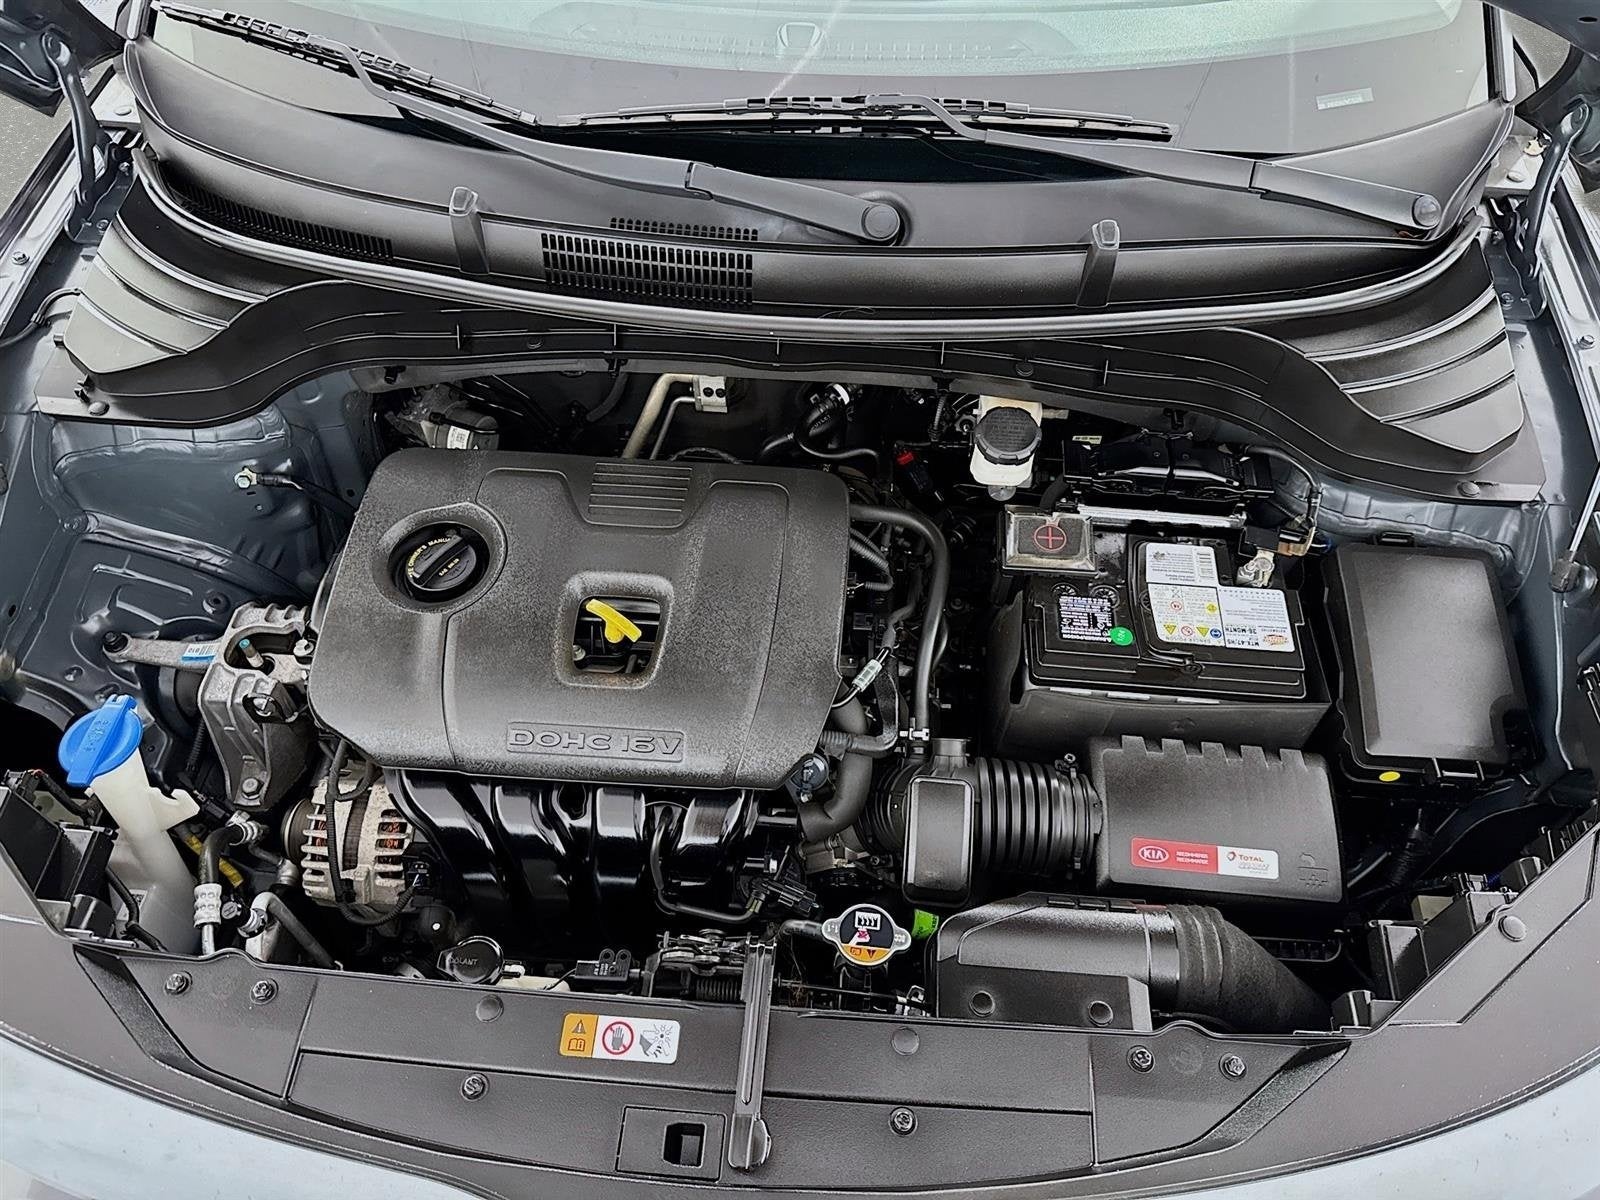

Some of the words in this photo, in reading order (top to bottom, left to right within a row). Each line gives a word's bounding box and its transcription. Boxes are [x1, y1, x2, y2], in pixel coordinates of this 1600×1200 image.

[509, 728, 612, 750] DOHC
[621, 735, 682, 755] 16V
[1143, 849, 1164, 860] KIA
[1238, 854, 1264, 862] TOTAL
